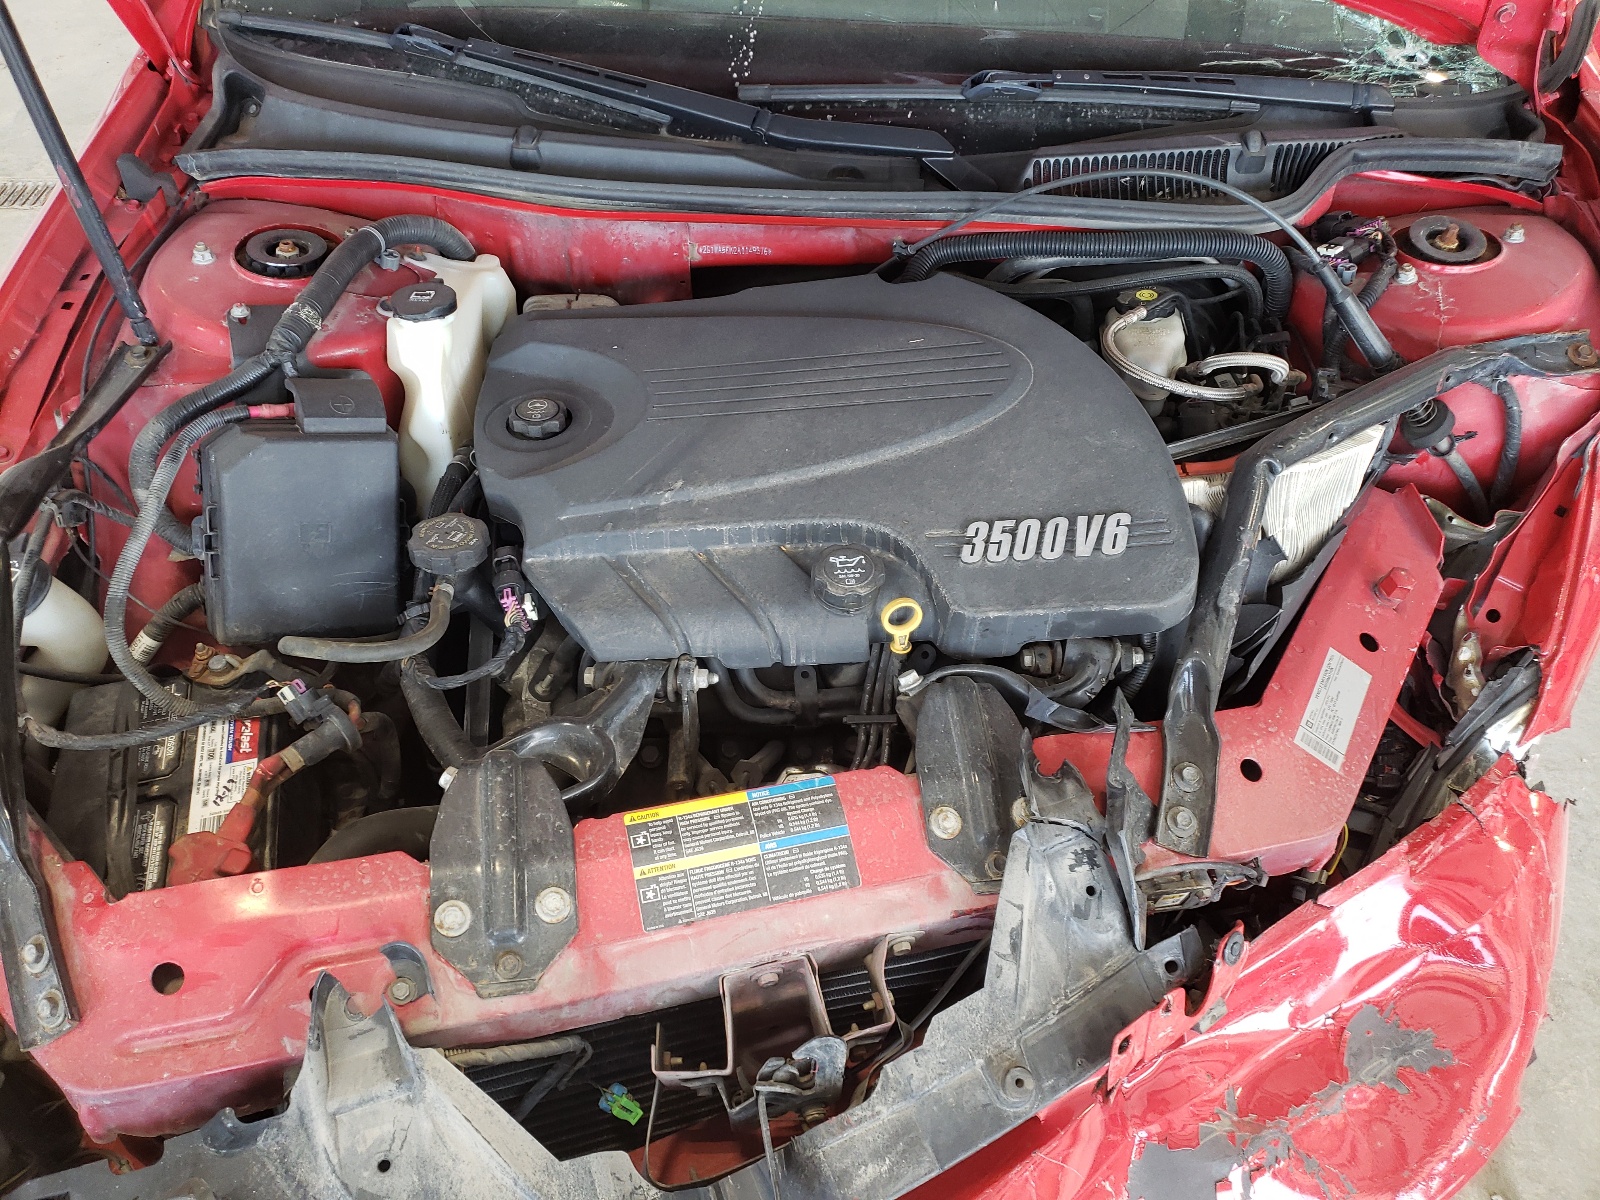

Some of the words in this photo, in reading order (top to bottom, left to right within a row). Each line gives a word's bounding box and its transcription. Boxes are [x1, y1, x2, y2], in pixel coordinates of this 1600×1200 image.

[960, 517, 1069, 564] 3500
[1075, 512, 1132, 558] V6
[752, 790, 770, 798] NOTICE
[637, 812, 660, 821] CAUTION
[764, 842, 777, 850] AVIS
[647, 863, 676, 874] ATTENTION
